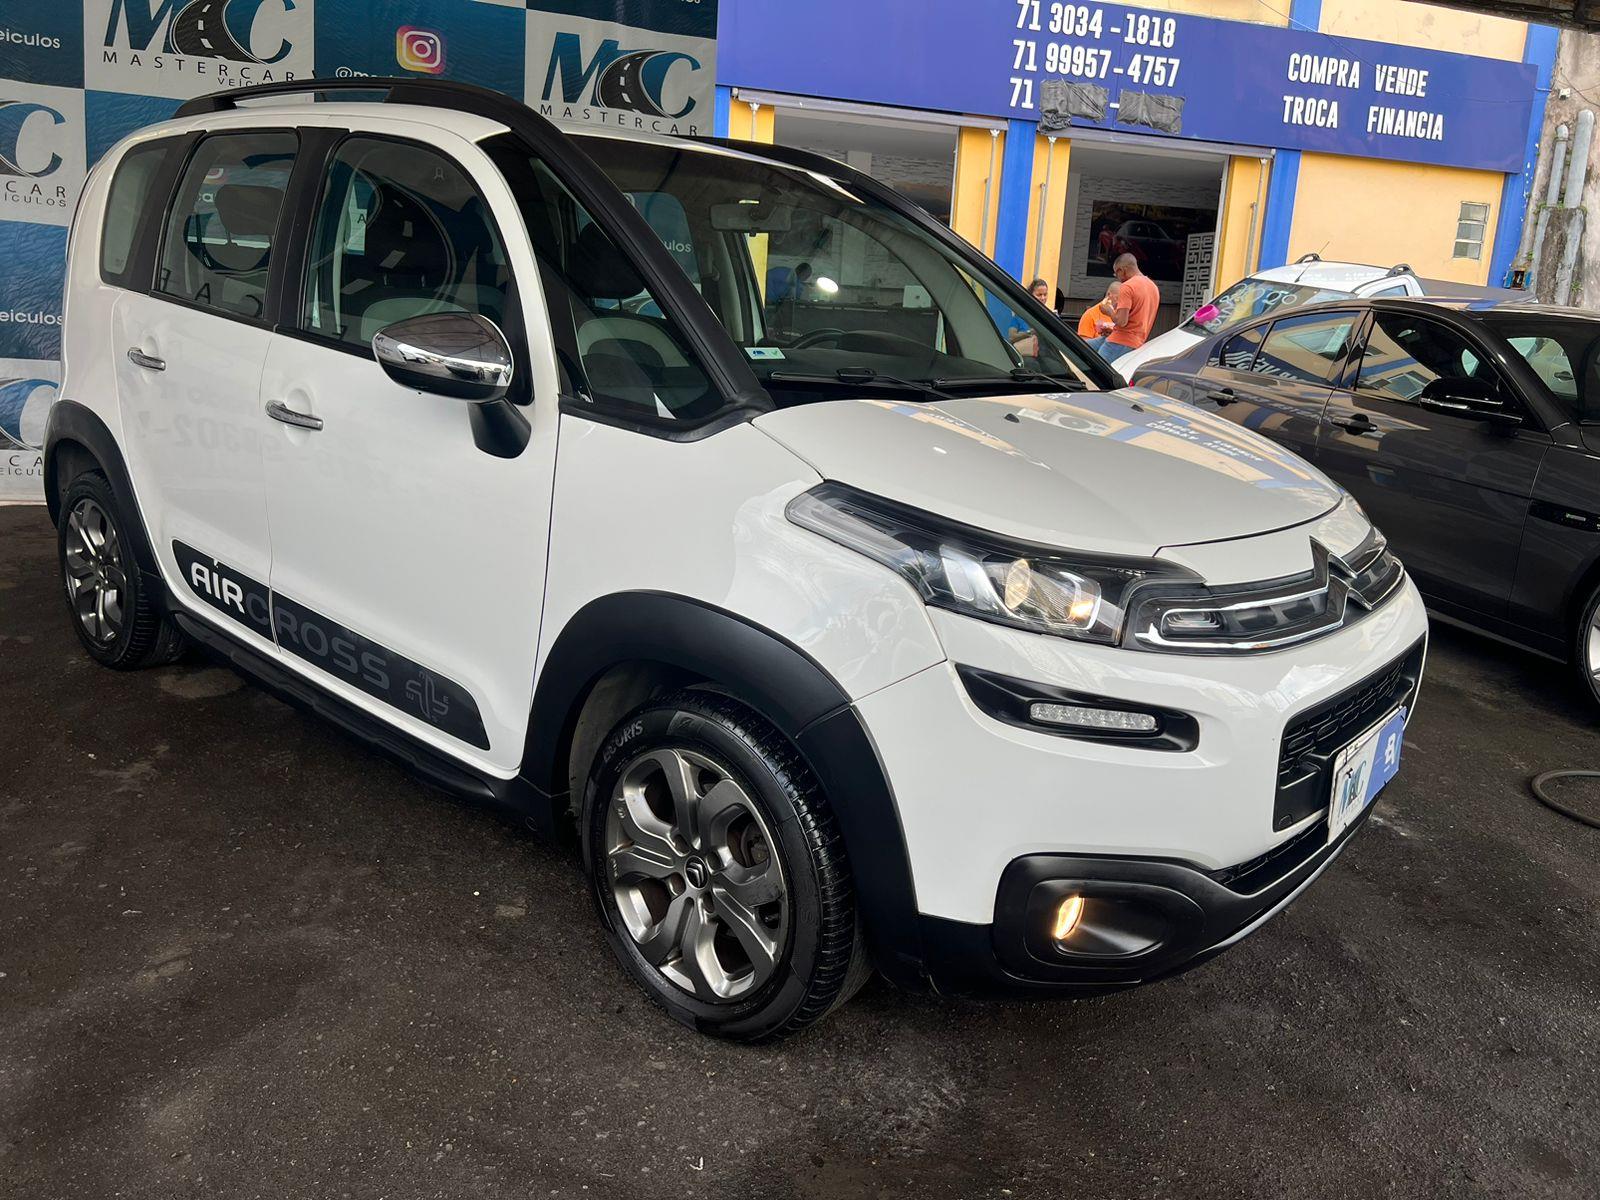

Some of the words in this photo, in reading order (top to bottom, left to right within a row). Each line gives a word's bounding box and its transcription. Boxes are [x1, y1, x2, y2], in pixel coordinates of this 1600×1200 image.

[1016, 0, 1041, 31] 71
[103, 51, 295, 82] MASTERCAR
[1013, 39, 1038, 72] 71
[1287, 53, 1360, 89] COMPRA
[1375, 64, 1430, 98] VENDE
[1009, 77, 1034, 109] 71
[540, 104, 698, 136] MASTERCAR
[1282, 95, 1338, 129] TROCA
[1366, 106, 1444, 141] FINANCIA
